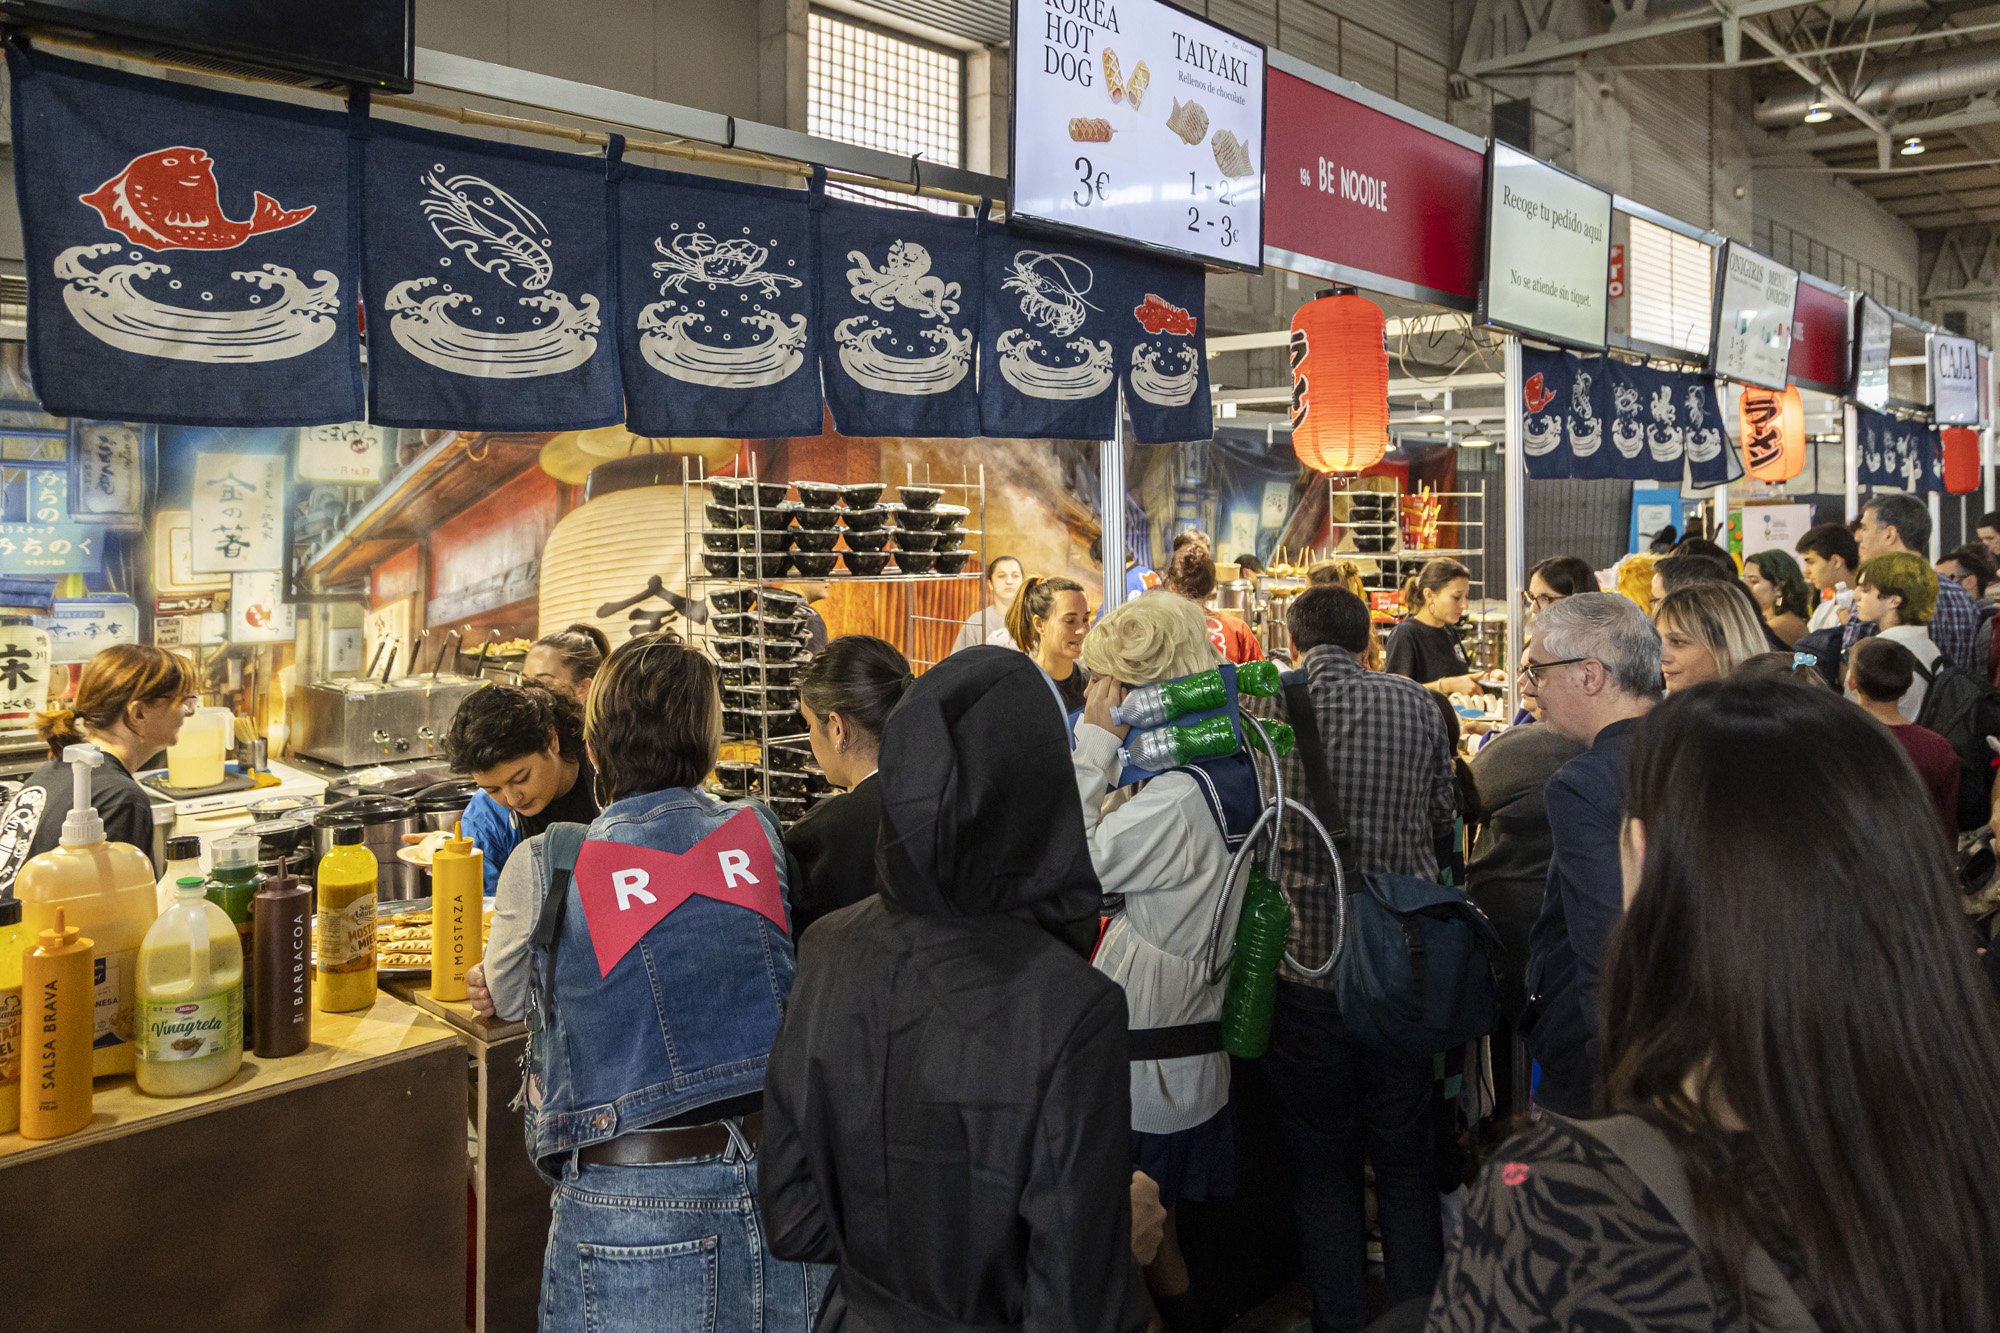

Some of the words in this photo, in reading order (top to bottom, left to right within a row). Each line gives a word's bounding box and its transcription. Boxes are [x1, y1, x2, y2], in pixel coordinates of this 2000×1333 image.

[1045, 0, 1120, 34] OREA
[1045, 11, 1094, 54] HOT
[1044, 44, 1093, 87] DOG
[1172, 31, 1248, 87] TAIYAKI
[1178, 70, 1207, 91] Rellenos
[1207, 81, 1216, 95] de
[1216, 86, 1246, 106] chocolate
[1073, 156, 1110, 207] 3€
[1319, 156, 1335, 194] BE
[1340, 166, 1388, 212] NOODLE
[1188, 206, 1200, 232] 2
[1503, 185, 1538, 220] Recoge
[1540, 202, 1550, 221] tu
[1551, 209, 1582, 235] pedido
[1584, 223, 1603, 244] aquí
[1510, 269, 1522, 286] No
[1523, 278, 1531, 289] se
[1532, 277, 1559, 297] atiende
[1559, 285, 1570, 301] sin
[1729, 252, 1764, 283] ONIGIRIS
[1939, 343, 1973, 380] CAJA
[612, 868, 657, 911] R
[718, 849, 760, 888] R
[454, 894, 465, 966] MOSTAZA
[293, 913, 305, 1007] BARBACOA
[43, 980, 58, 1033] BRAVA
[95, 997, 119, 1008] NESA
[151, 1016, 222, 1038] Vinagreta
[42, 1040, 56, 1090] SALSA
